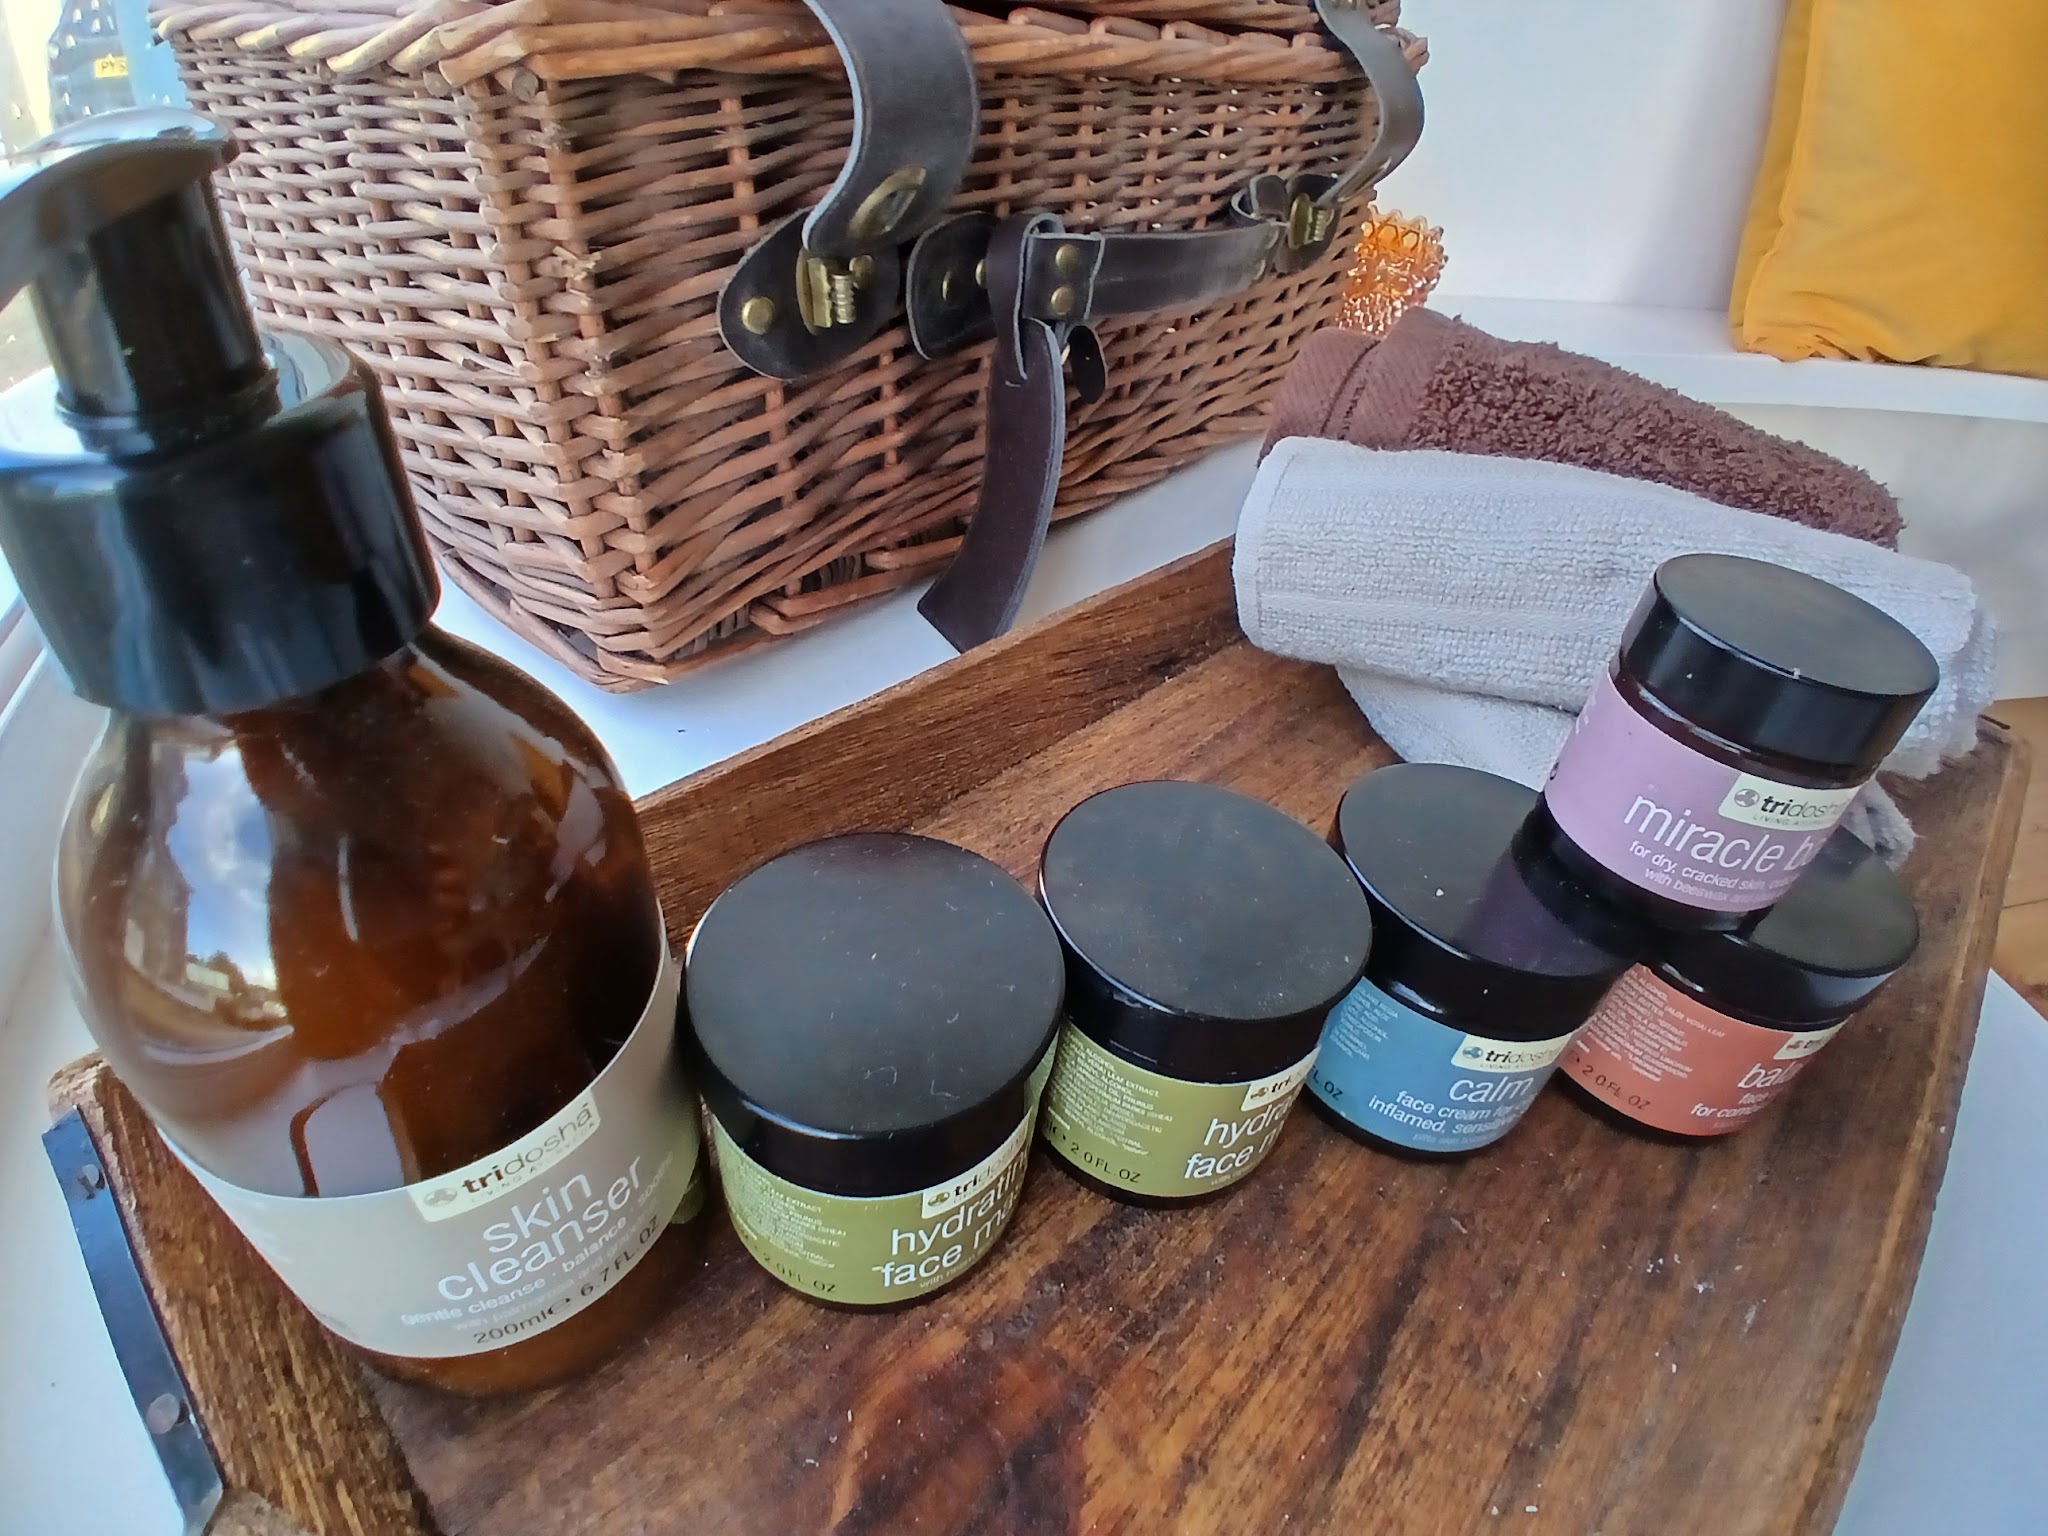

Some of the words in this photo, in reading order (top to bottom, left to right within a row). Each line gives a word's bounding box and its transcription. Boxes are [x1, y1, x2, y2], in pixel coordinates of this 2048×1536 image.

[1624, 795, 1785, 873] miracle
[1629, 840, 1651, 858] for
[1652, 853, 1677, 874] dry,
[1681, 865, 1739, 889] cracked
[1645, 867, 1673, 886] with
[1396, 1090, 1435, 1113] face
[1438, 1105, 1491, 1121] cream
[1449, 1076, 1534, 1102] calm
[1691, 1103, 1717, 1117] for
[1184, 1145, 1254, 1179] face
[437, 1156, 641, 1300] cleanser
[483, 1174, 592, 1253] skin
[468, 1278, 547, 1314] cleanse
[561, 1216, 627, 1273] balance
[881, 1244, 963, 1288] face
